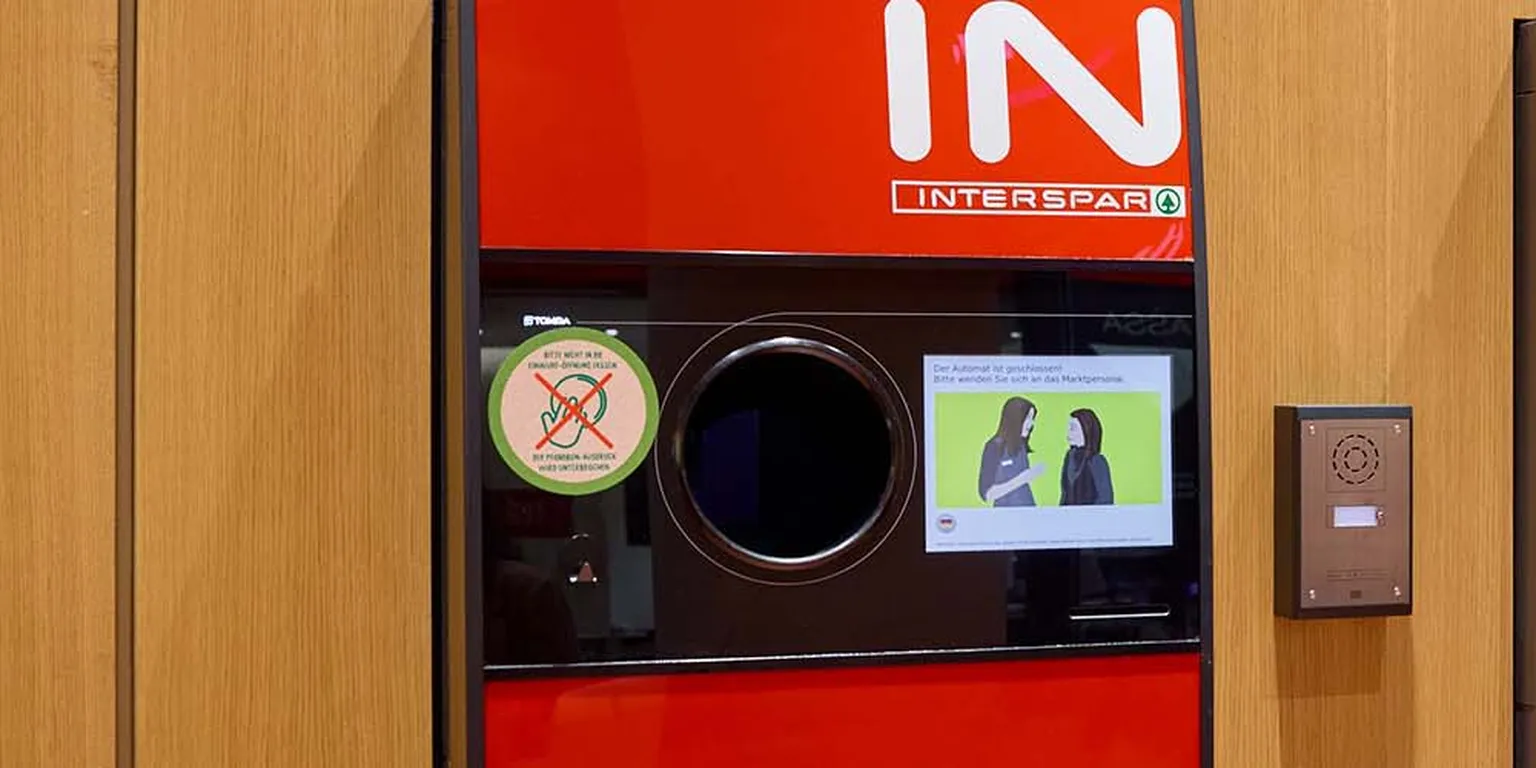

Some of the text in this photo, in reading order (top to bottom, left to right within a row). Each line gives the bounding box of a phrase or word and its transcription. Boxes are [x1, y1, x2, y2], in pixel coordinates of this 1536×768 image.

[884, 0, 1182, 167] IN
[918, 187, 1148, 210] INTERSPAR
[952, 364, 990, 373] Automat
[934, 375, 955, 384] Bitte
